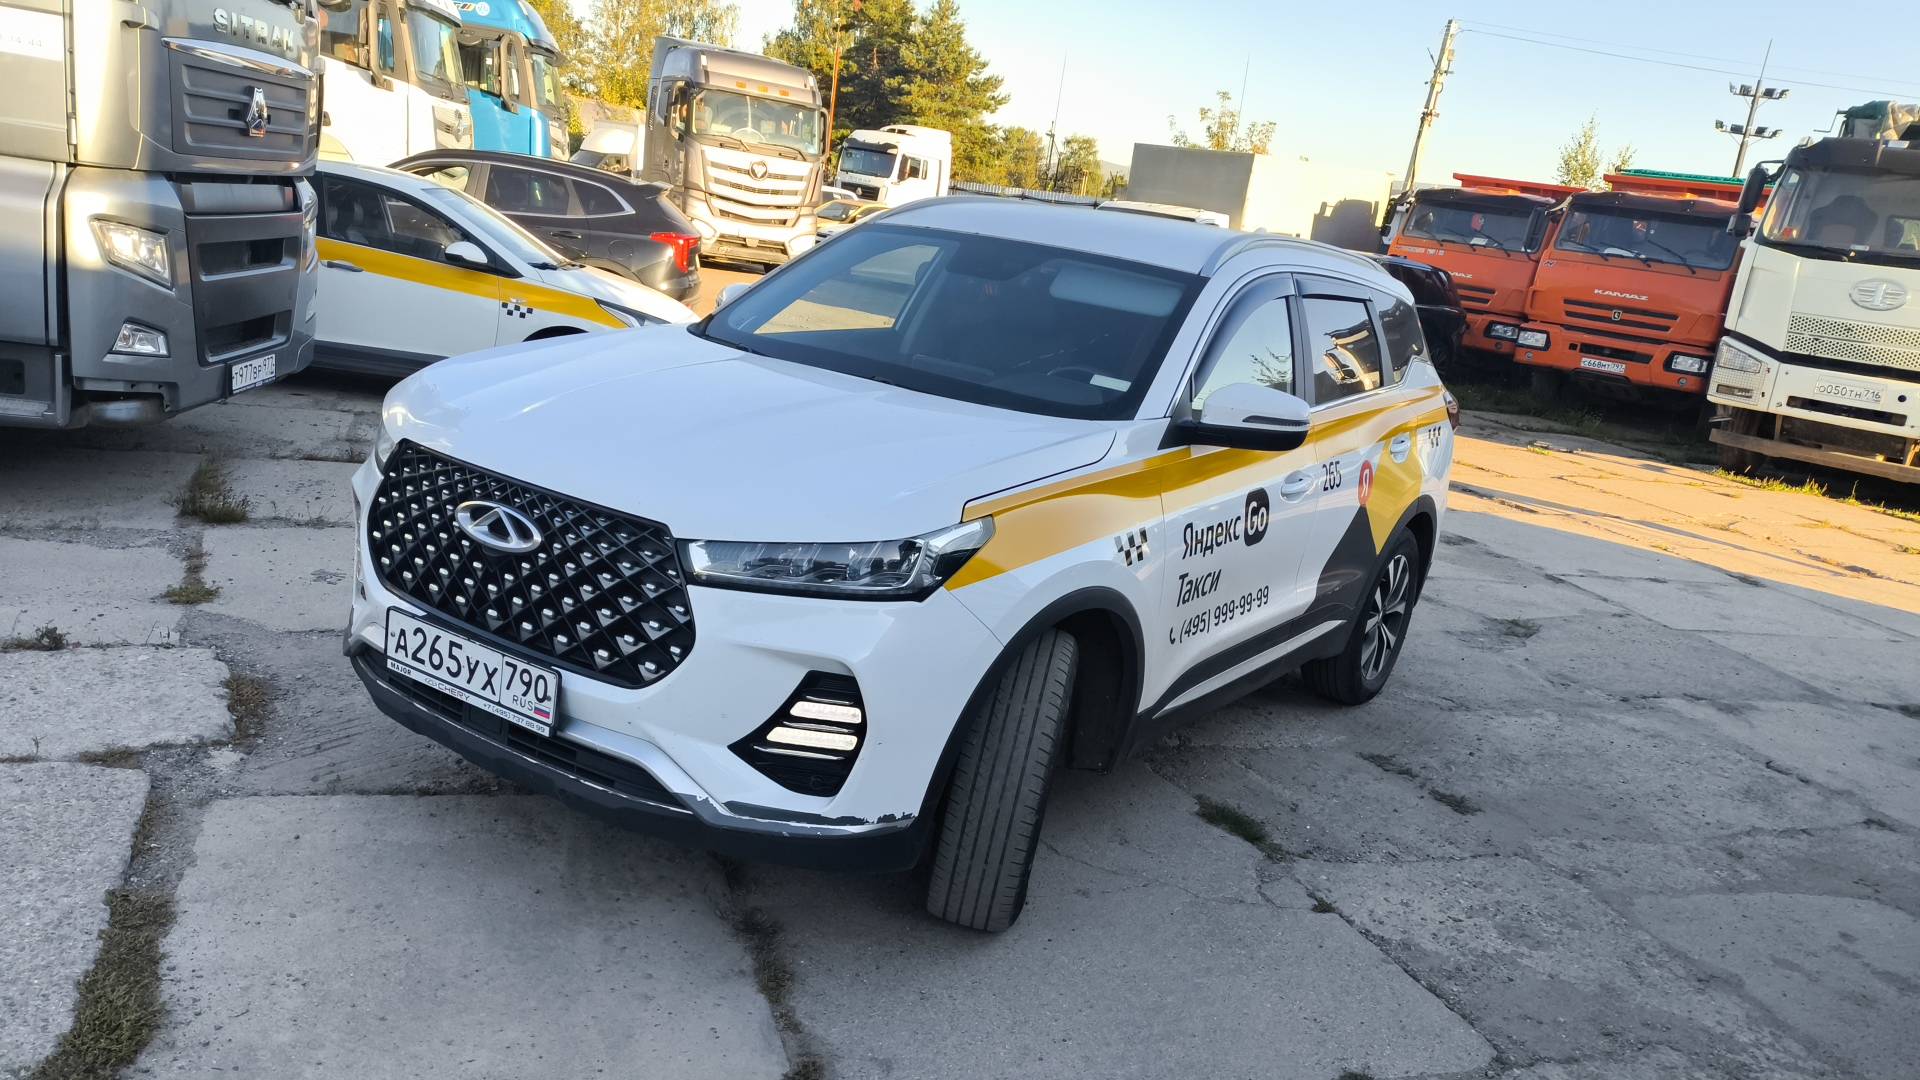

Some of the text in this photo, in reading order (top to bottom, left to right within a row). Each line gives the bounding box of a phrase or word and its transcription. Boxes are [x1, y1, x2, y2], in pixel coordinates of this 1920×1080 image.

[213, 7, 296, 52] SITRAK
[1446, 270, 1473, 279] MAZ
[1594, 288, 1648, 301] KAMAZ
[1322, 460, 1342, 492] 265
[1182, 501, 1267, 560] Яндекс Go
[1176, 568, 1222, 608] Такси
[1179, 585, 1270, 644] (495) 999-99-99
[390, 661, 412, 676] MAJOR
[437, 682, 470, 701] CHERY
[512, 694, 534, 712] RUS
